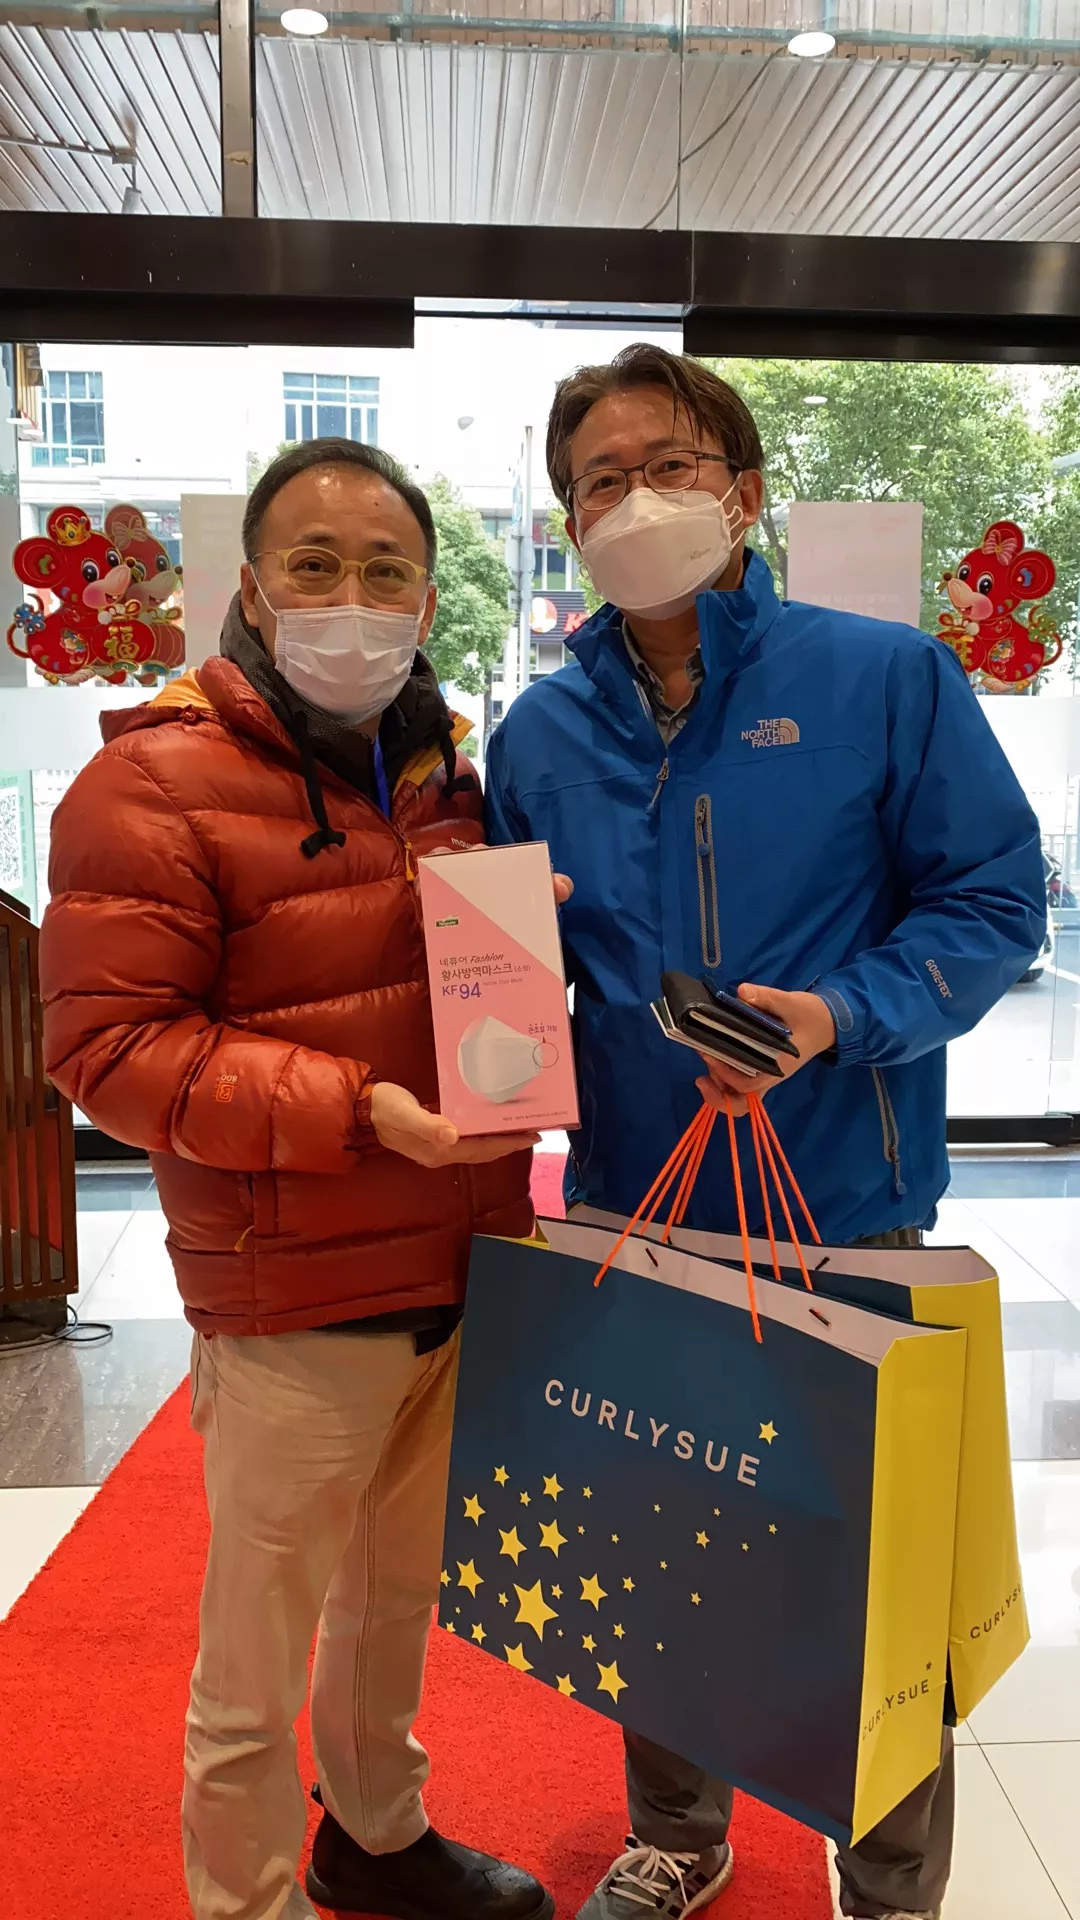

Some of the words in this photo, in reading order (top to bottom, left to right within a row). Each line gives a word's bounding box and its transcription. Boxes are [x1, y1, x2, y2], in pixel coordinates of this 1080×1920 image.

[104, 625, 139, 659] 福
[757, 718, 780, 729] THE
[741, 727, 780, 740] NORTH
[751, 736, 780, 748] FACE
[440, 956, 468, 967] 네퓨어
[470, 953, 504, 964] Fashion
[441, 963, 513, 982] 황사방역마스크
[442, 982, 482, 1000] KF94
[544, 1379, 761, 1488] CURLYSUE
